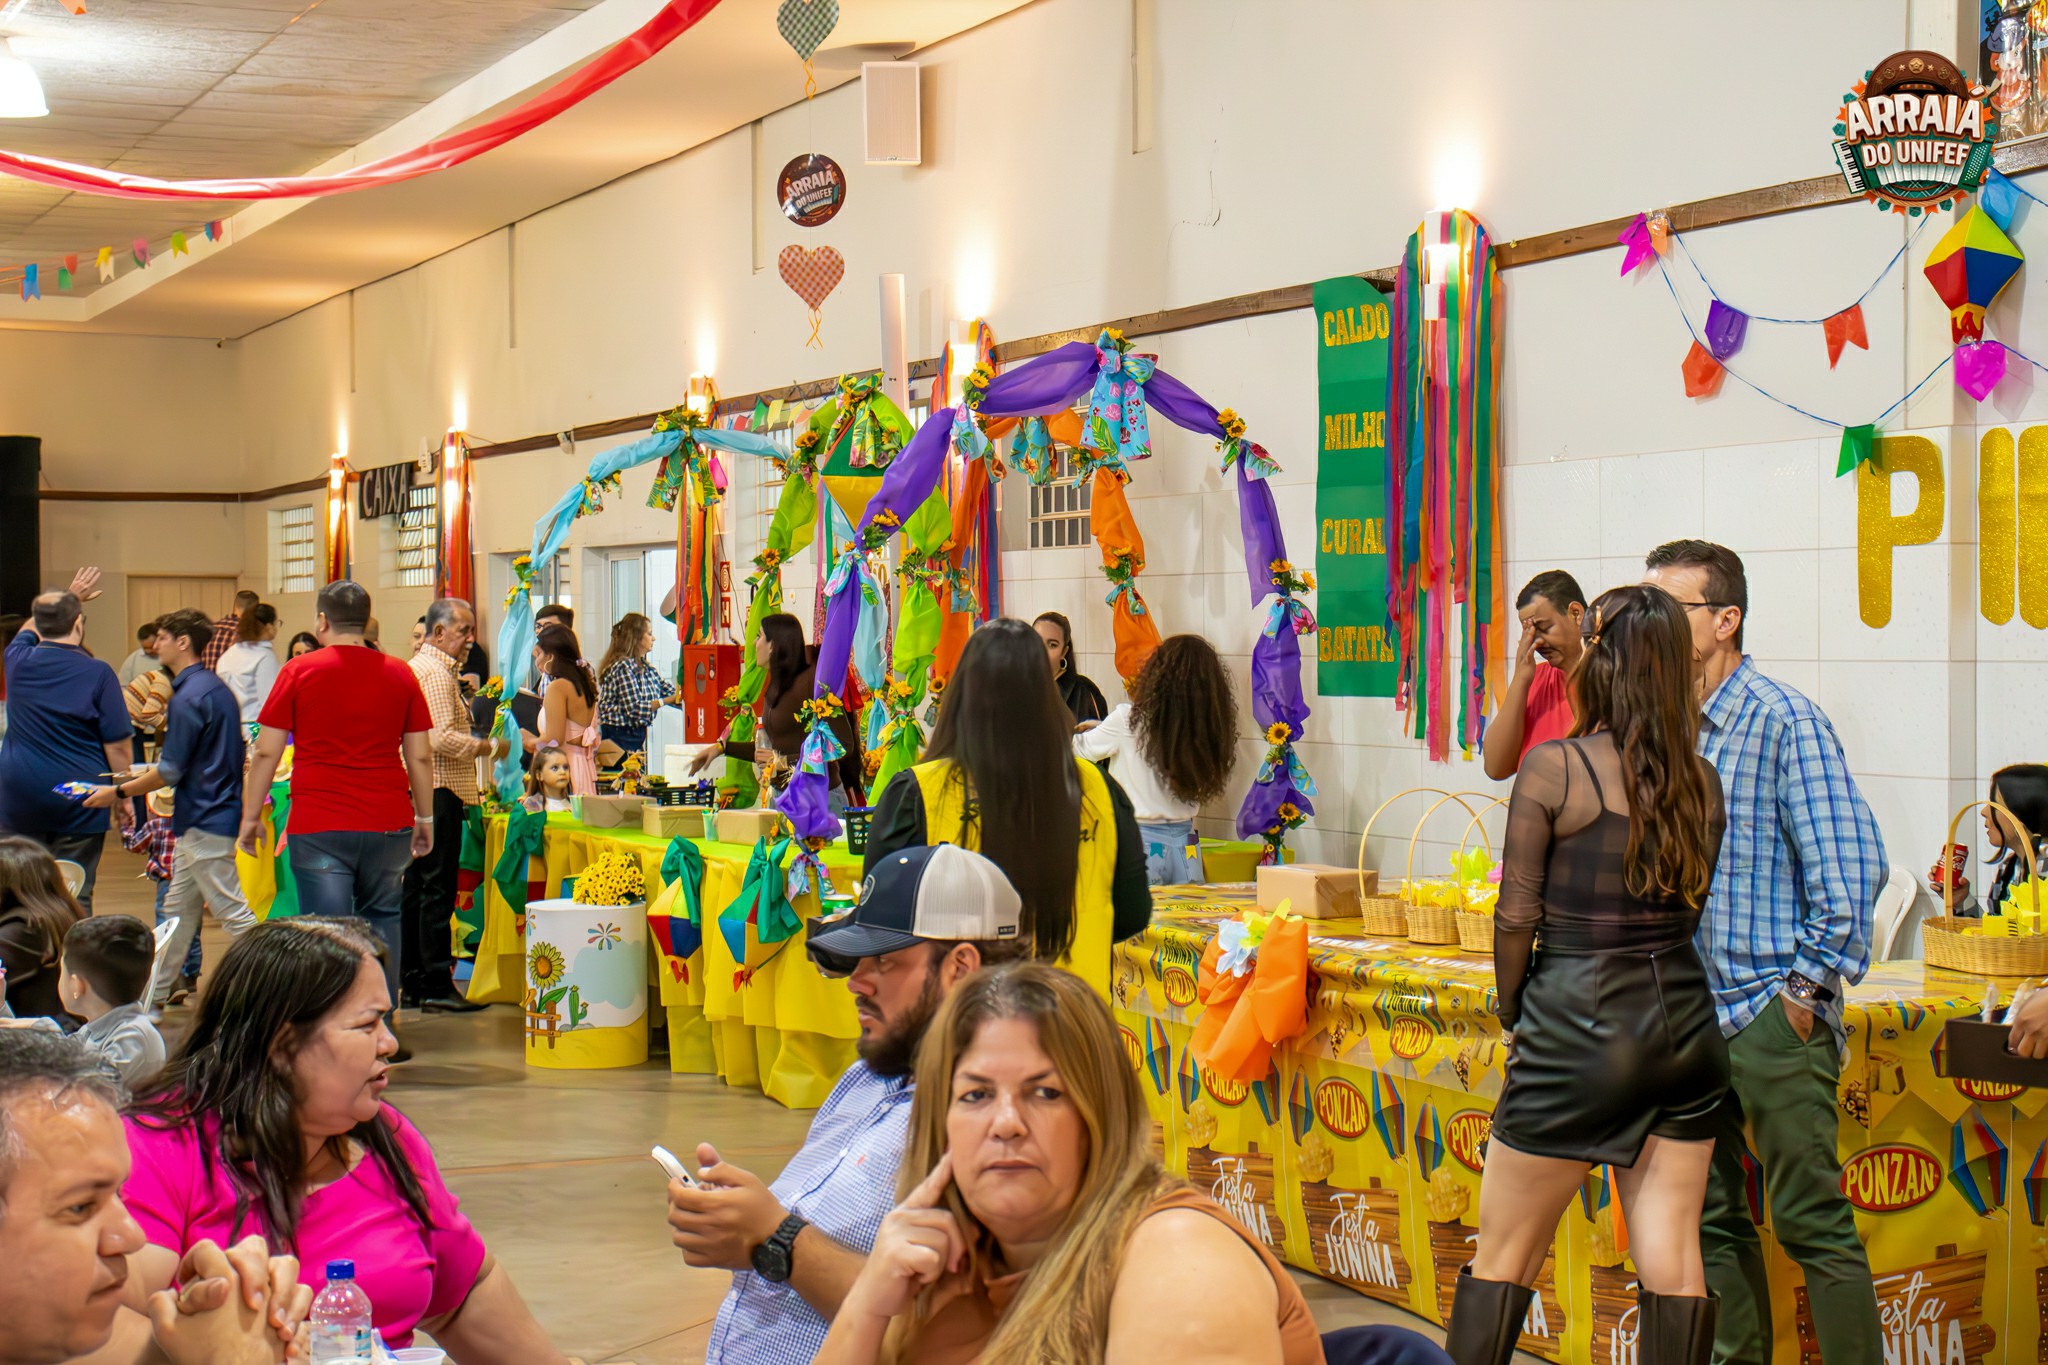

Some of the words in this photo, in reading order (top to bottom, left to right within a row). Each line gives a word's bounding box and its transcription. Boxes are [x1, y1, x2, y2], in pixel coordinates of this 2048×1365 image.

[795, 198, 806, 209] DO
[807, 187, 833, 203] UNIFEF
[1323, 302, 1390, 347] CALDO
[363, 463, 408, 517] CAIXA
[1392, 1019, 1432, 1056] PONZAN
[1318, 1085, 1366, 1133] PONZAN
[1211, 1156, 1257, 1207] Festa
[1845, 1152, 1936, 1206] PONZAN
[1329, 1192, 1380, 1247] Festa
[1325, 1233, 1399, 1290] JUNINA
